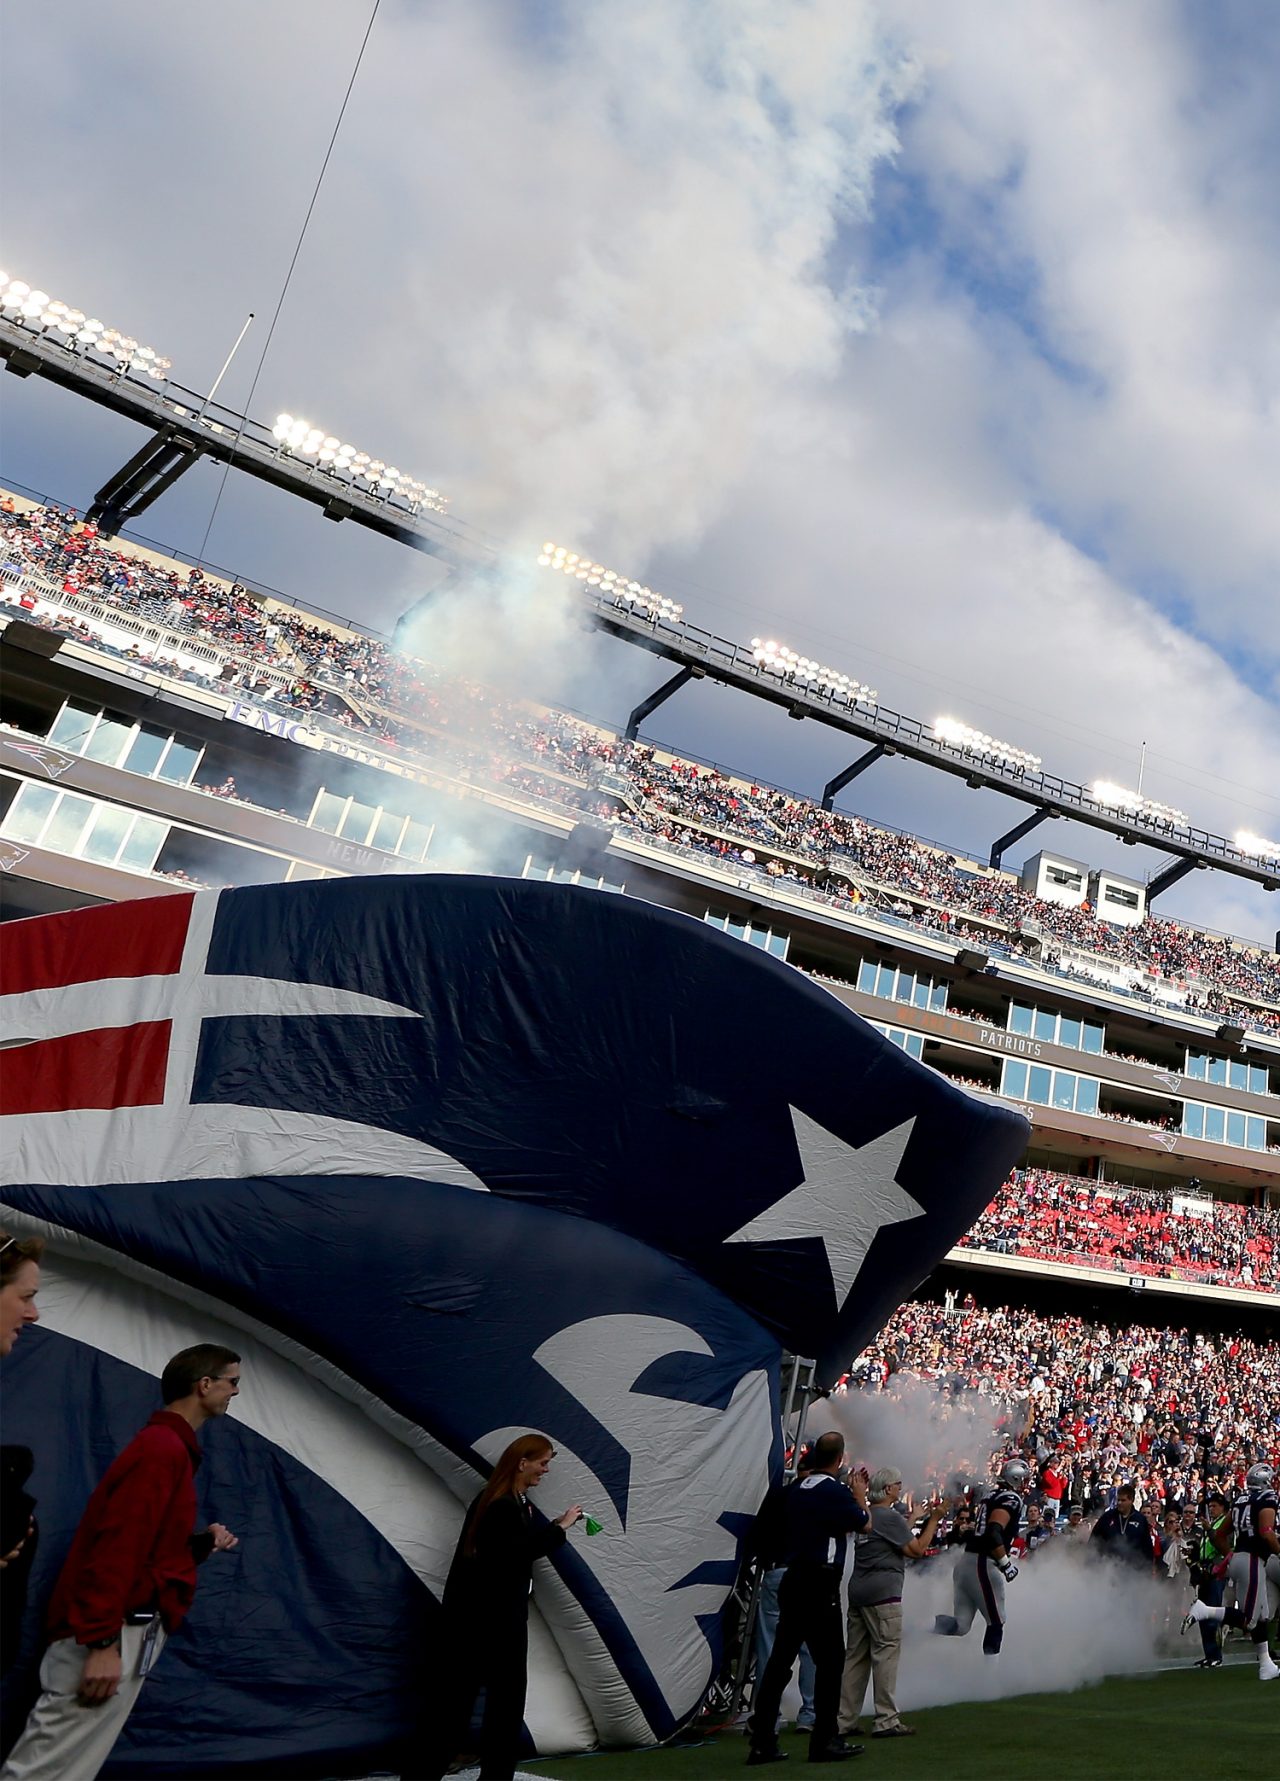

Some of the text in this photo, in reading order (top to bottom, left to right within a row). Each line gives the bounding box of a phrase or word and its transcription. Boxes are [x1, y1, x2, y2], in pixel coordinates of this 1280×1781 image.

[326, 841, 374, 866] NEW
[980, 1029, 1042, 1056] PATRIOTS
[1231, 1504, 1255, 1538] 94
